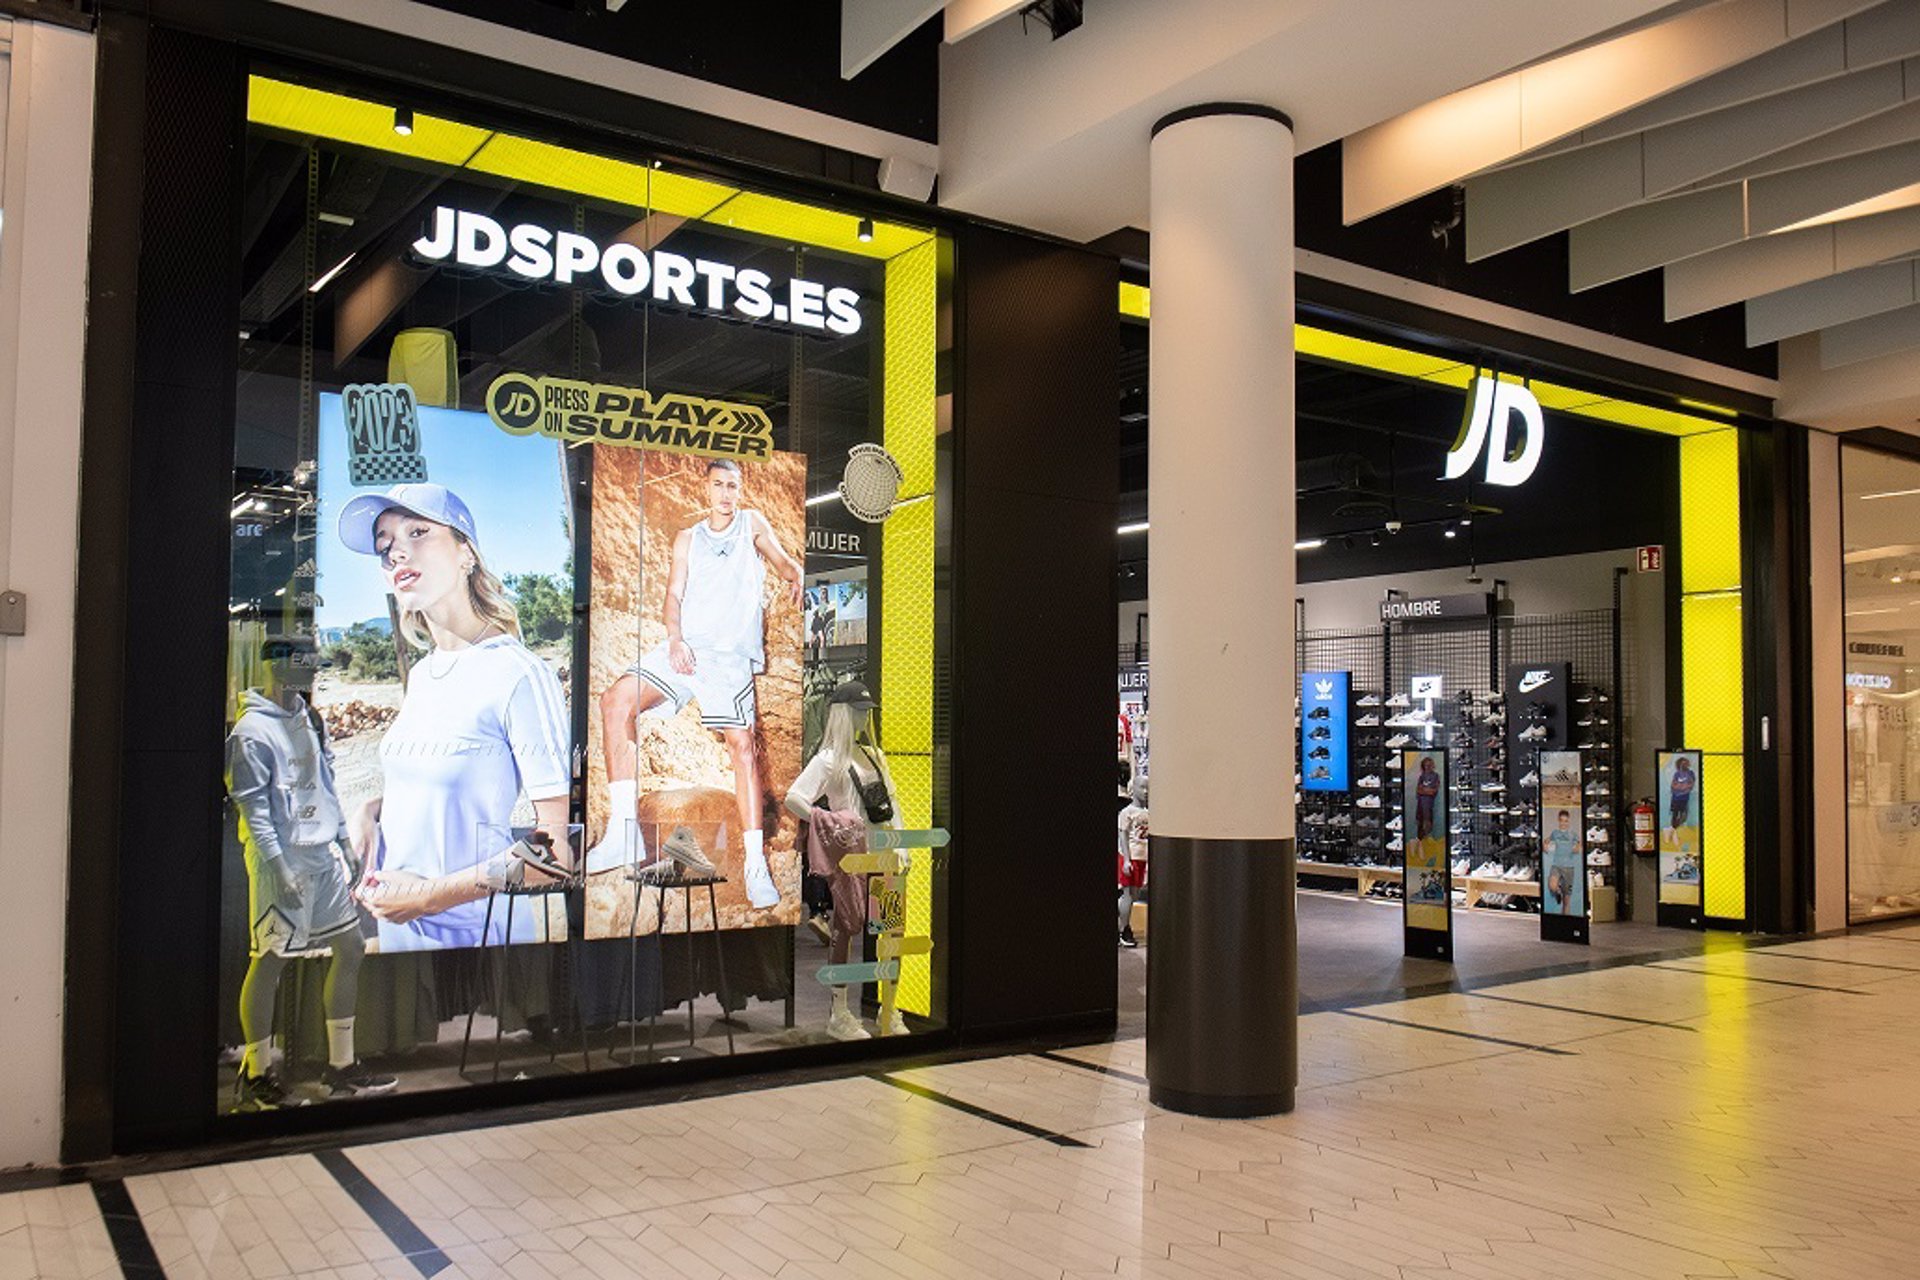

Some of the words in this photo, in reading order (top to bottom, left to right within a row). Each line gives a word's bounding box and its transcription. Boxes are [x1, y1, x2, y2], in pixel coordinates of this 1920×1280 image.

[413, 206, 863, 337] JDSPORTS.ES
[345, 386, 418, 455] 2023
[500, 391, 537, 418] JD
[544, 384, 589, 412] PRESS
[595, 391, 722, 427] PLAY
[544, 410, 563, 433] ON
[566, 413, 768, 457] SUMMER
[1445, 374, 1545, 487] JD
[1381, 600, 1442, 619] HOMBRE
[1118, 672, 1149, 687] UJER
